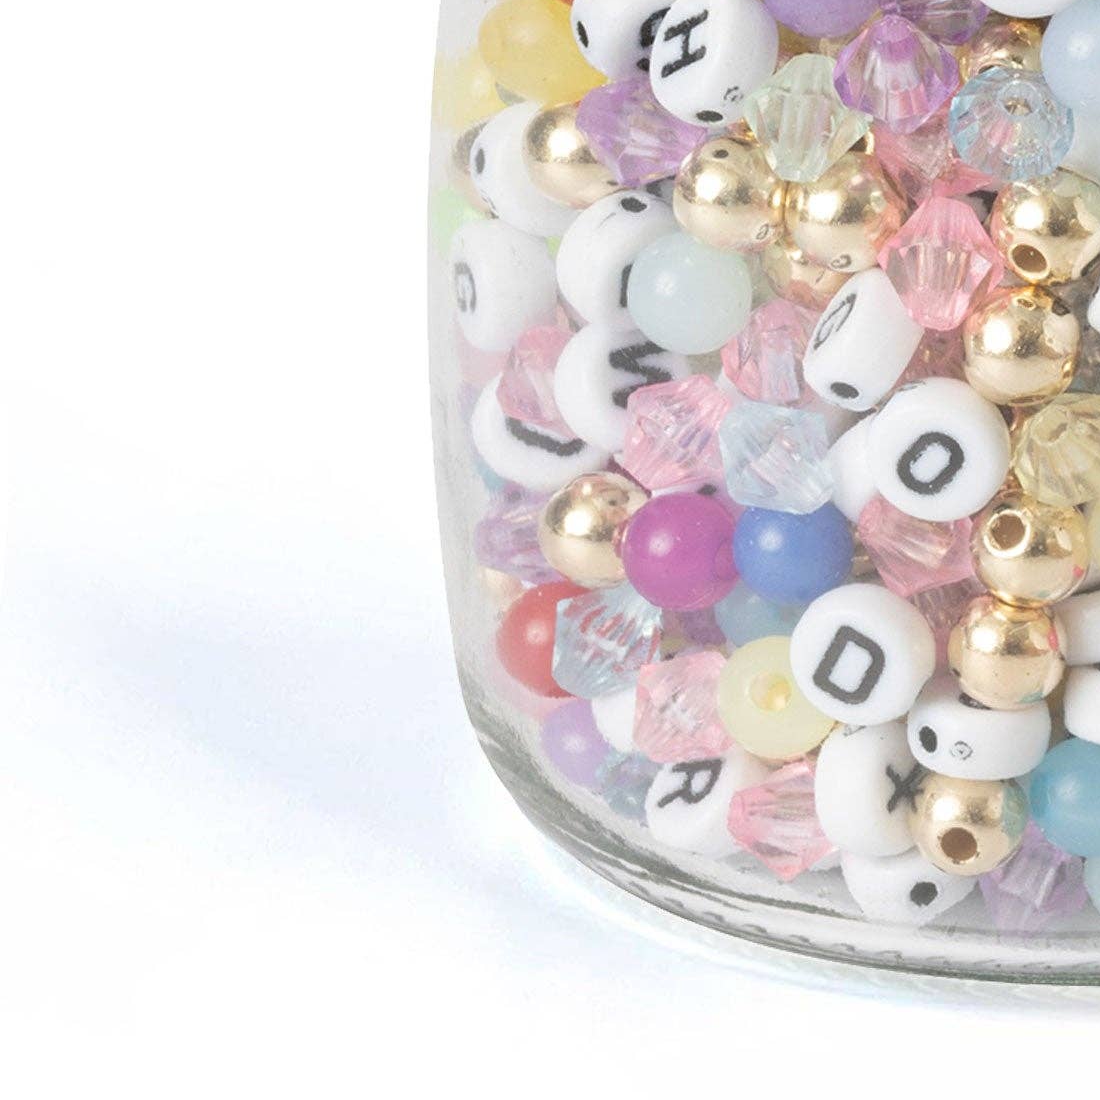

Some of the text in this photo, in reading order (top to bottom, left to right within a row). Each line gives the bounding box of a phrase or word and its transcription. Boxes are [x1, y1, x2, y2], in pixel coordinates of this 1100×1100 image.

[661, 9, 709, 78] H
[812, 624, 887, 706] D
[657, 759, 723, 810] R
